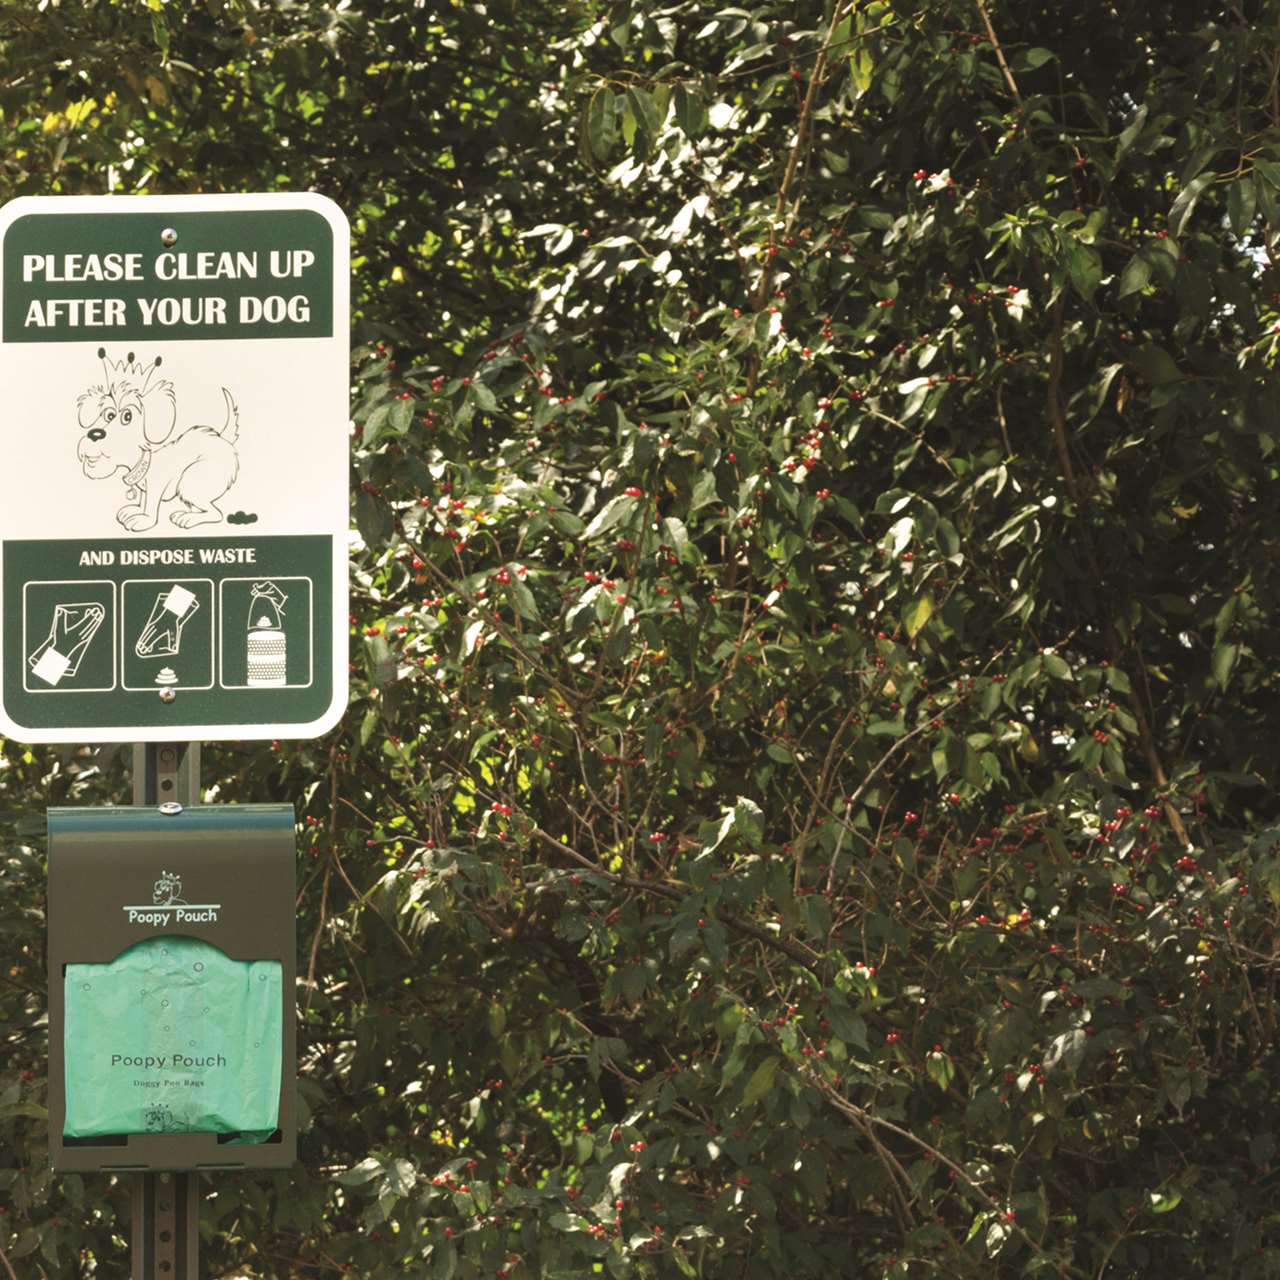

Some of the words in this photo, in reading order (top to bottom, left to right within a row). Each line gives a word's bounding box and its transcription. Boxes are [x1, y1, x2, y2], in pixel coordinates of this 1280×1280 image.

[23, 254, 144, 282] PLEASE
[154, 251, 258, 281] CLEAN
[269, 250, 315, 278] UP
[24, 299, 126, 327] AFTER
[137, 297, 227, 326] YOUR
[239, 295, 310, 323] DOG
[79, 550, 115, 566] AND
[120, 549, 194, 565] DISPOSE
[199, 548, 257, 564] WASTE
[129, 910, 170, 926] Poopy
[176, 908, 217, 922] Pouch
[111, 1054, 166, 1069] Poopy
[172, 1054, 227, 1067] Pouch
